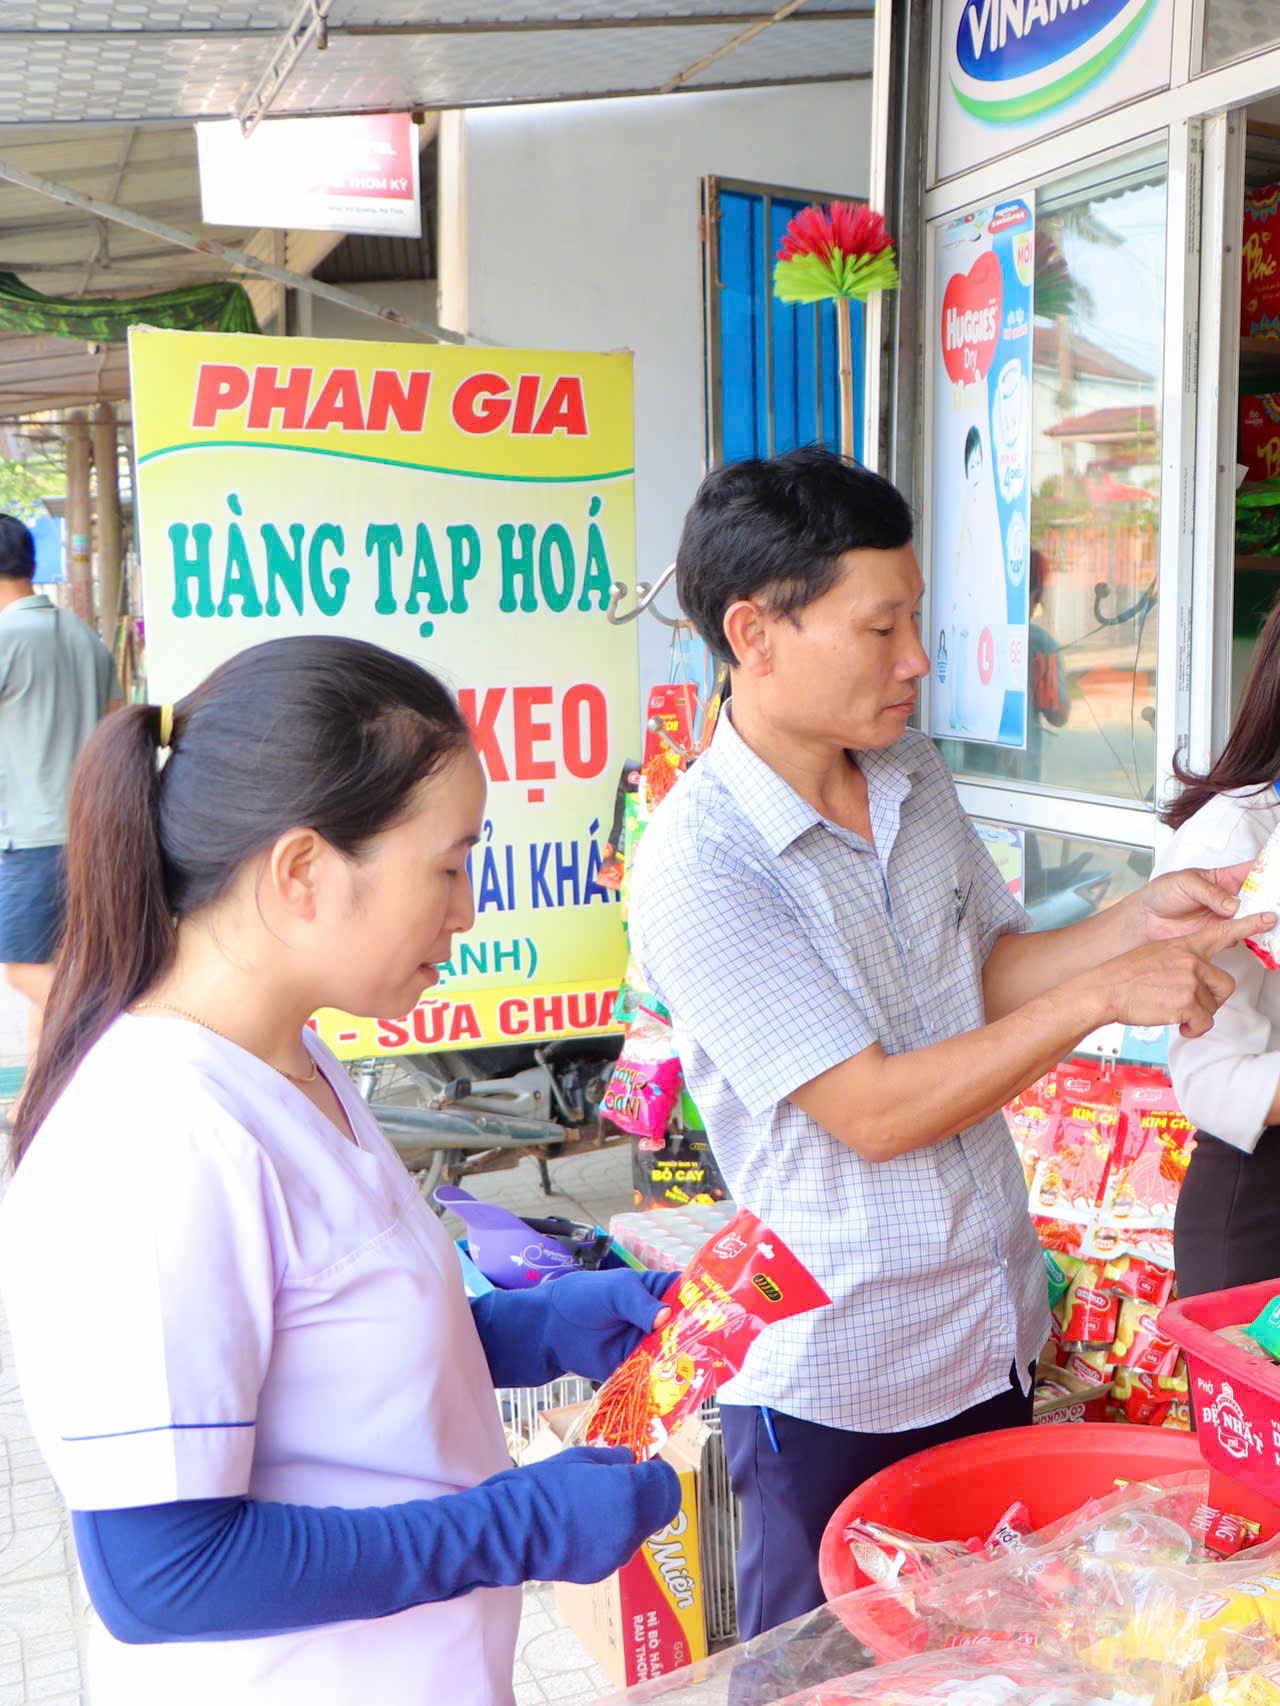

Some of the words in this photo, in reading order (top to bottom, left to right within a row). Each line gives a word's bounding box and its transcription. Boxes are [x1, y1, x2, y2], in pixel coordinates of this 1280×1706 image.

[964, 348, 978, 373] Dry
[192, 364, 431, 432] PHAN
[451, 372, 589, 436] GIA
[168, 493, 350, 618] HÀNG
[365, 522, 482, 638] TẠP
[497, 495, 612, 613] HOÁ
[457, 683, 609, 803] KẸO
[466, 819, 516, 914] ẢI
[437, 937, 538, 985] ẠNH)
[377, 997, 482, 1049] SỮA
[499, 989, 624, 1036] CHUA
[1072, 1107, 1096, 1122] KIM
[1099, 1112, 1117, 1125] CH
[1141, 1116, 1167, 1129] KIM
[1169, 1118, 1195, 1131] CH
[651, 1167, 674, 1182] BÒ
[679, 1169, 704, 1183] CAY
[1198, 1377, 1214, 1395] PHỞ
[1203, 1403, 1220, 1428] ĐỆ
[1223, 1411, 1264, 1455] NHẤT
[647, 1540, 696, 1609] Miền
[633, 1614, 645, 1642] RAU
[646, 1610, 658, 1628] MÌ
[648, 1630, 661, 1650] BÒ
[673, 1640, 685, 1668] GOL
